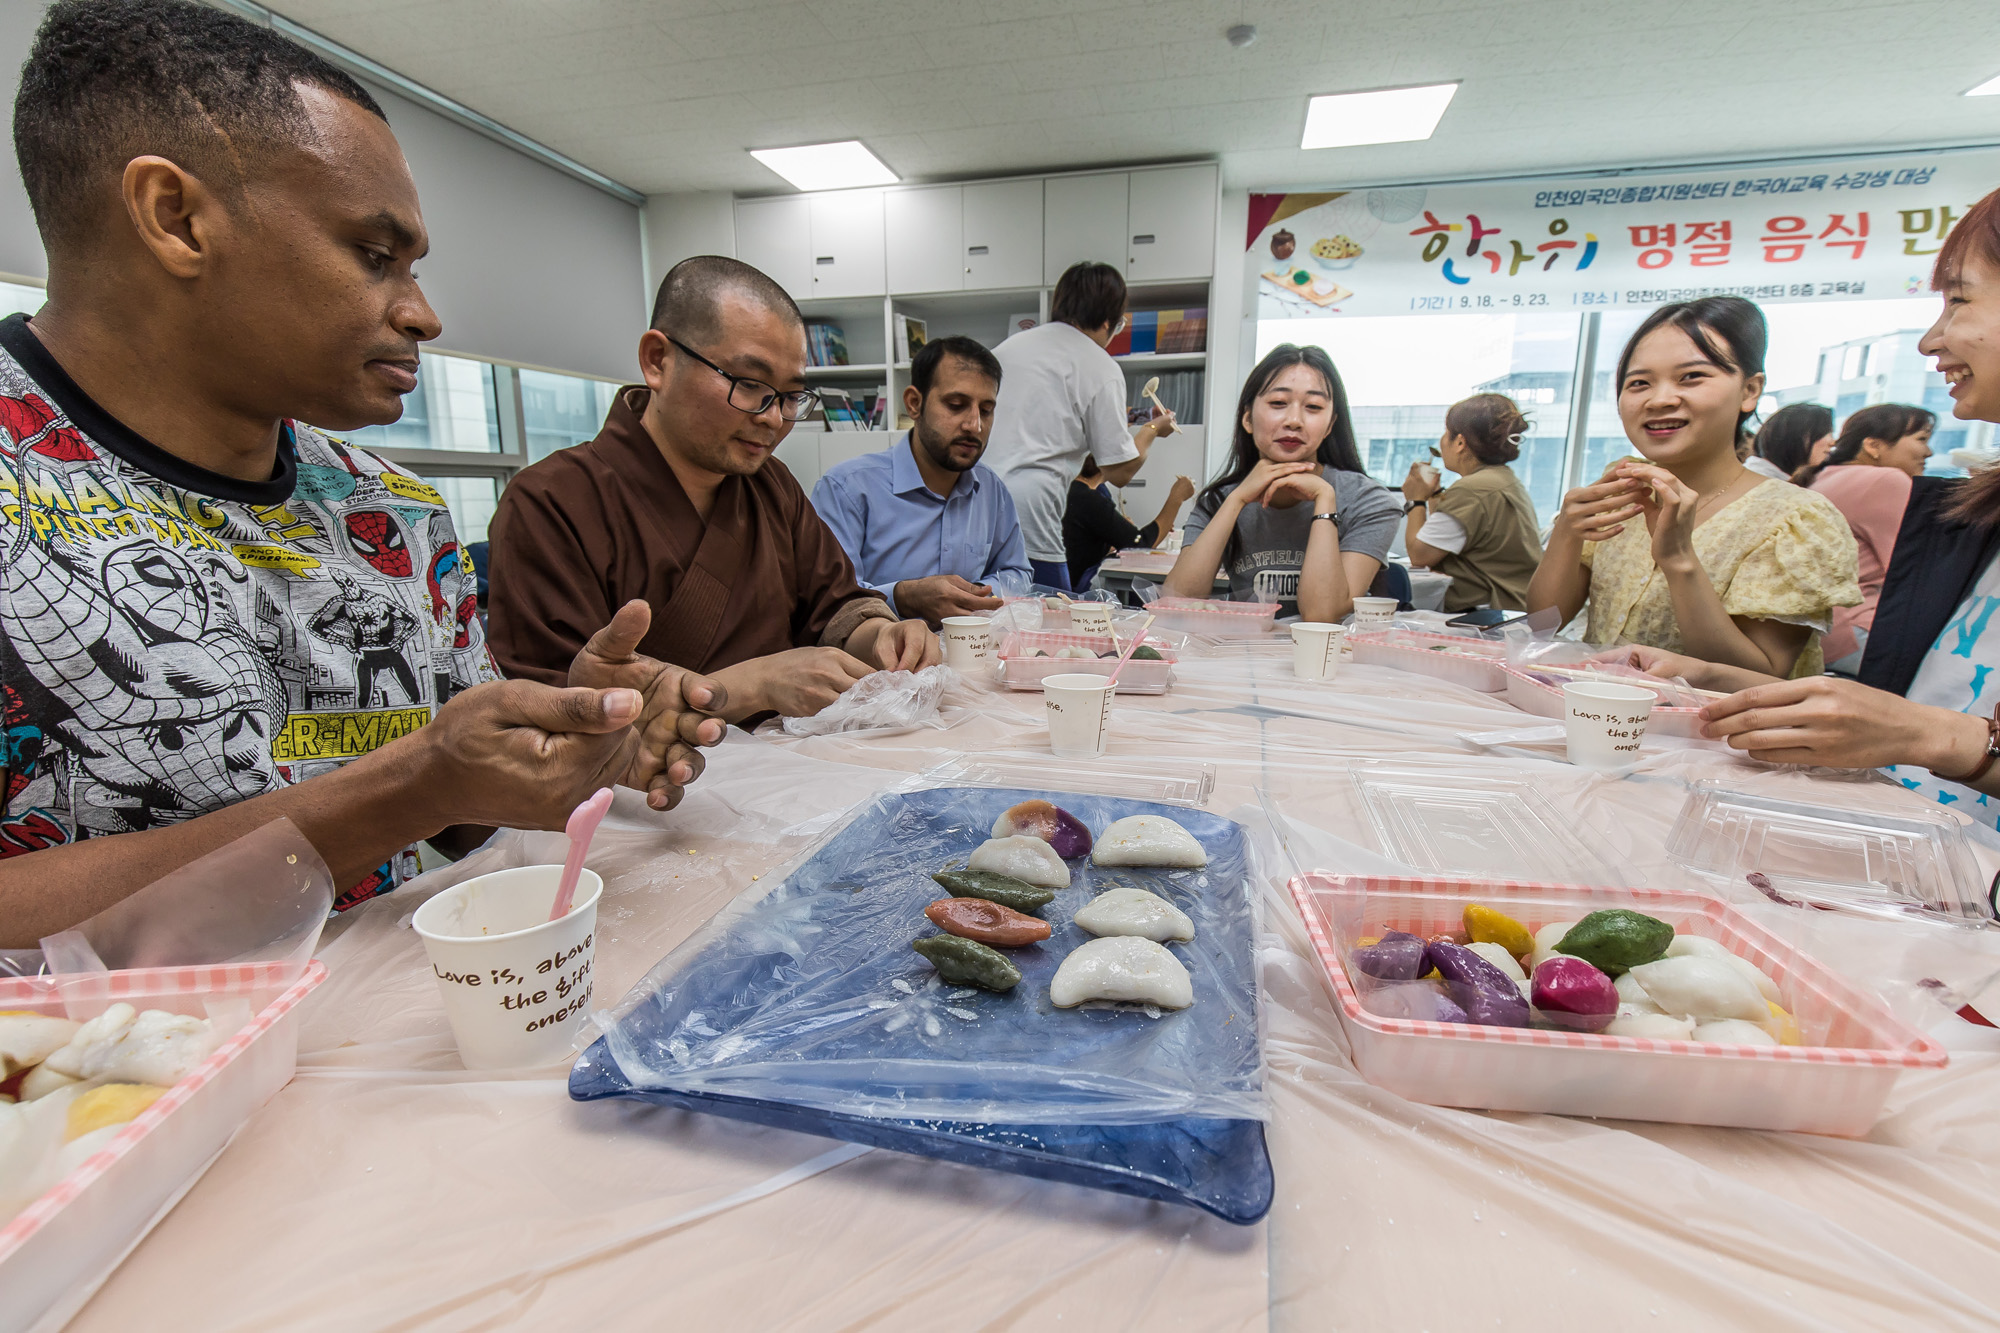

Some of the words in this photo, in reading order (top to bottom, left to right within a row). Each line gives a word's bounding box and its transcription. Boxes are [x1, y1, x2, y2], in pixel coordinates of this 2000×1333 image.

[1535, 181, 1729, 208] 인천외국인종합지원센터
[1732, 174, 1829, 197] 한국어교육
[1831, 169, 1893, 190] 수강생
[1893, 166, 1937, 186] 대상
[1409, 211, 1598, 285] 한가위
[1627, 220, 1732, 269] 명절
[1759, 211, 1870, 263] 음식
[1897, 206, 1975, 255] 만
[1419, 296, 1445, 309] 기간
[1581, 292, 1609, 304] 장소
[1819, 281, 1866, 296] 교육실
[345, 492, 390, 505] STARTING
[1233, 550, 1304, 575] MAYFIELD
[1573, 708, 1601, 721] Love
[1606, 714, 1621, 725] is,
[1607, 728, 1629, 738] the
[433, 962, 482, 987] Love
[491, 967, 524, 985] is,
[536, 933, 592, 975] above
[499, 988, 548, 1010] the
[555, 959, 591, 999] gift
